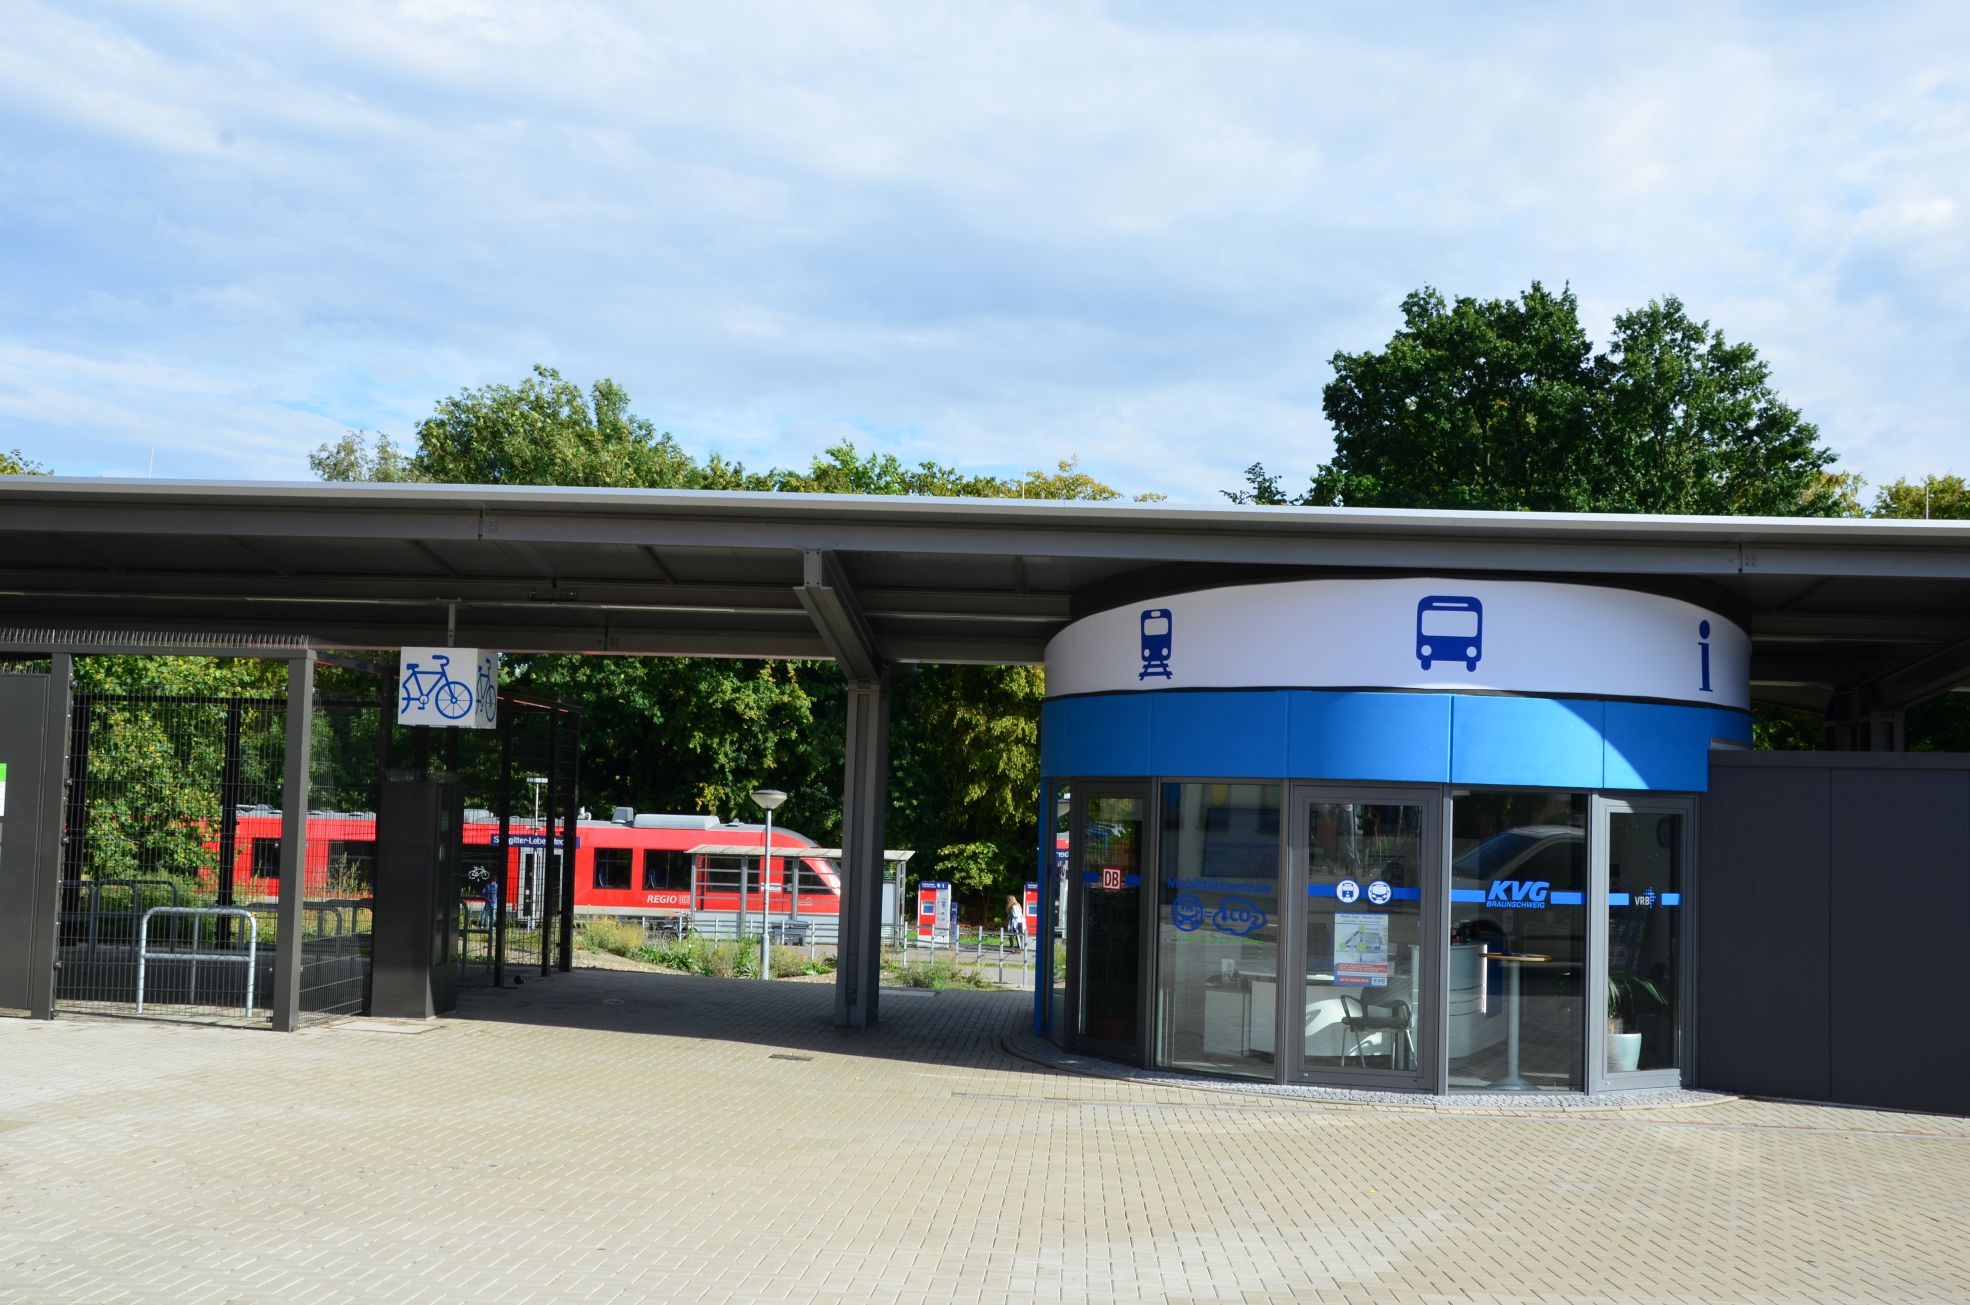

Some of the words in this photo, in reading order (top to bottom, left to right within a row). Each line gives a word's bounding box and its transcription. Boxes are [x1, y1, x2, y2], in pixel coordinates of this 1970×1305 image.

[1104, 870, 1119, 887] DB
[1487, 880, 1550, 901] KVG
[646, 894, 677, 904] REGIO
[1486, 900, 1546, 909] BRAUNSCHWEIG
[1634, 895, 1651, 906] VRB
